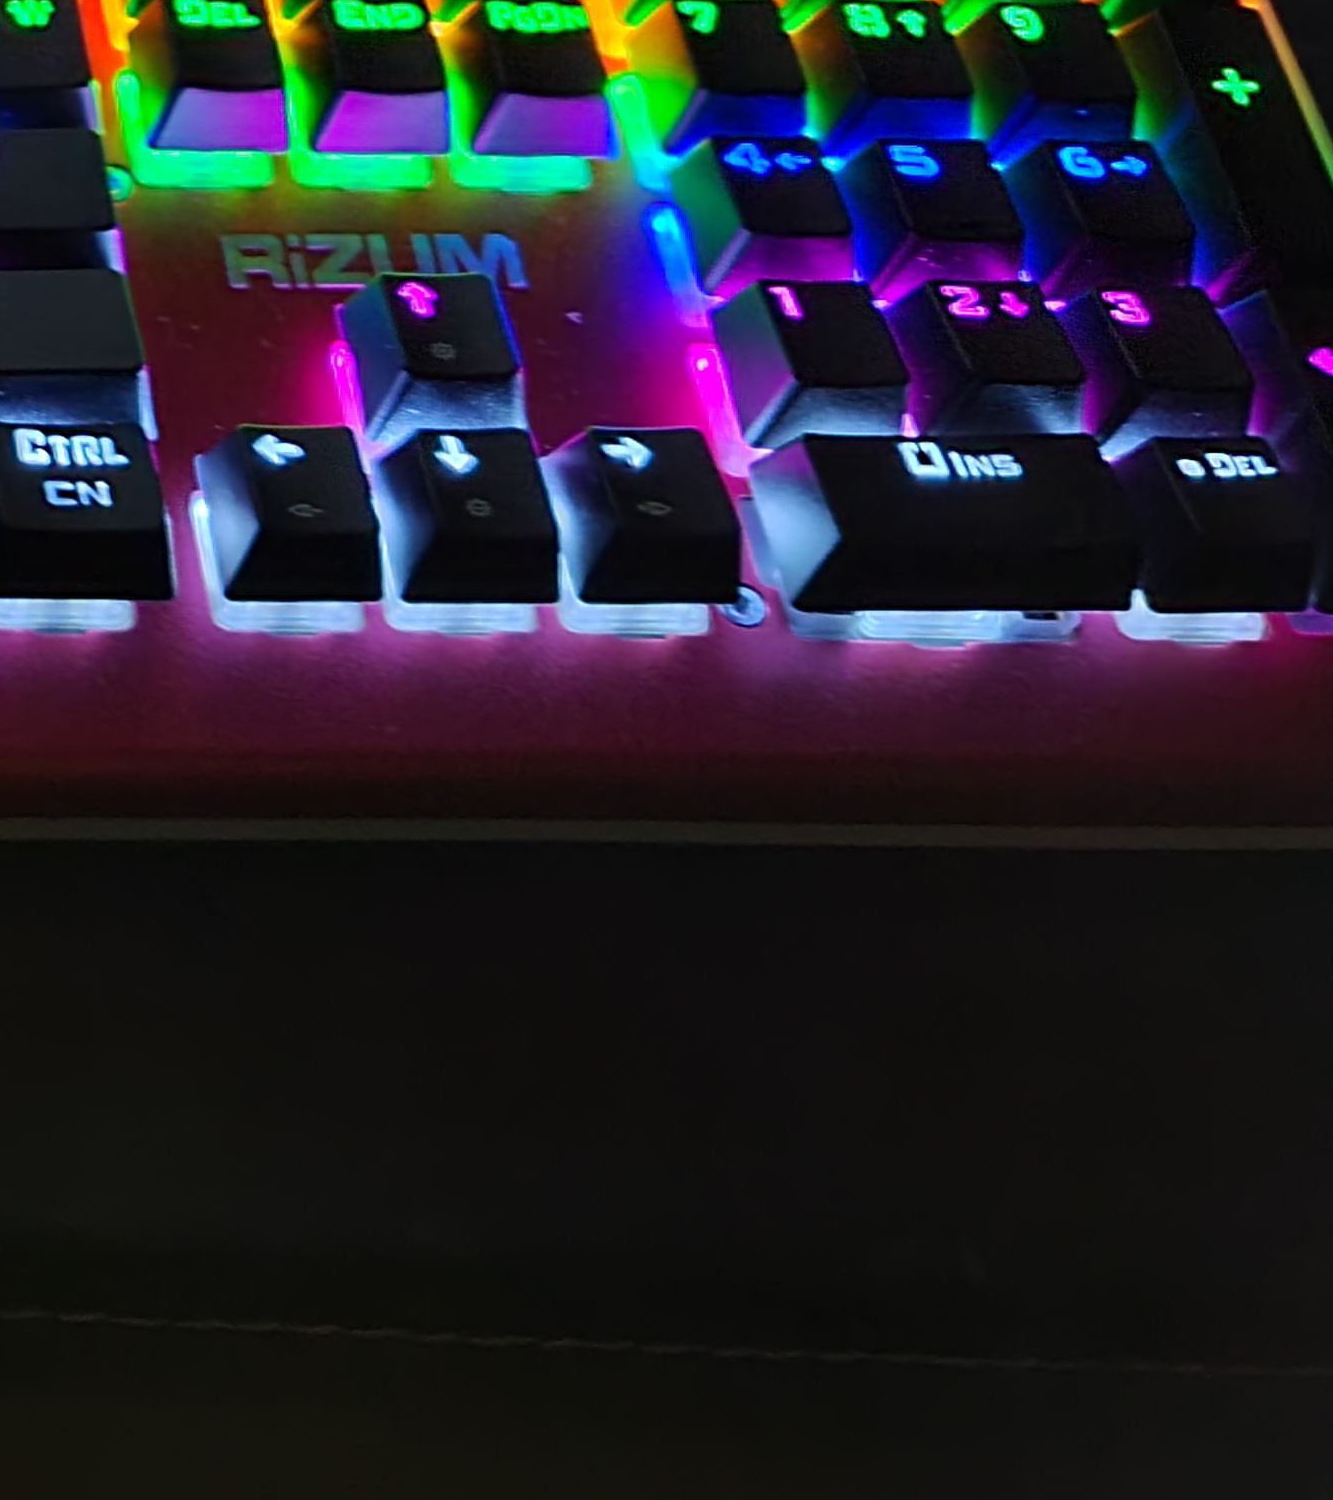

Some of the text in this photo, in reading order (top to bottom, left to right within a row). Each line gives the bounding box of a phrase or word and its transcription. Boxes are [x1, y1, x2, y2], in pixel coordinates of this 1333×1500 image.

[678, 0, 718, 32] 7
[844, 4, 891, 39] 8
[1001, 5, 1044, 41] 9
[724, 142, 772, 175] 4
[887, 144, 939, 179] 5
[1058, 145, 1105, 180] 6
[768, 286, 804, 320] 1
[938, 286, 991, 318] 2
[1101, 291, 1151, 326] 3
[42, 478, 113, 509] CN
